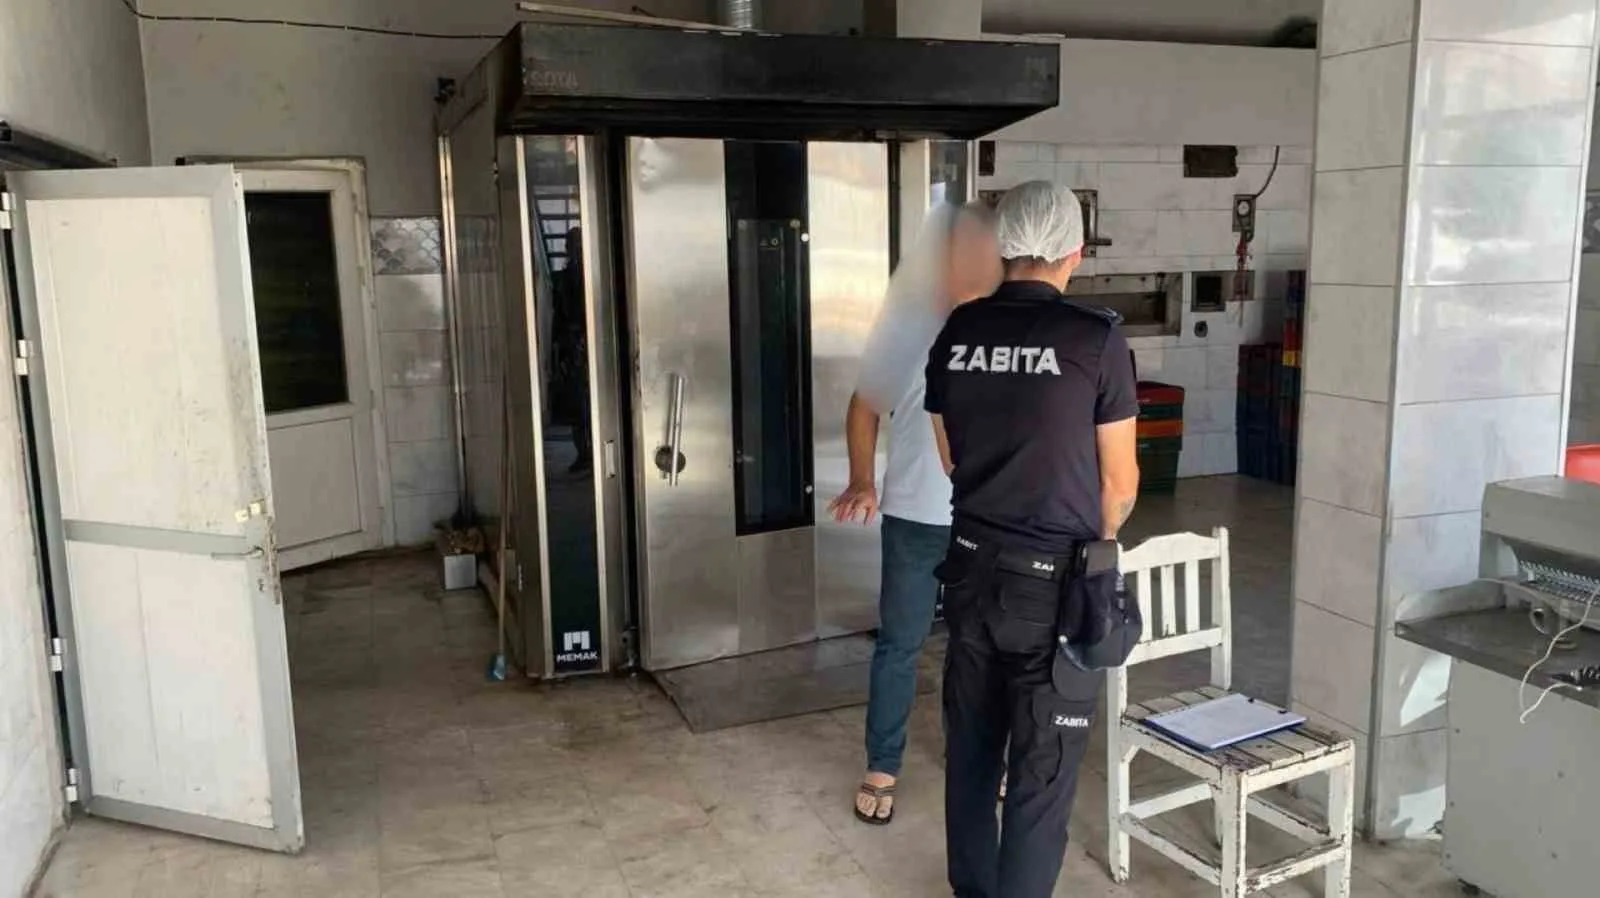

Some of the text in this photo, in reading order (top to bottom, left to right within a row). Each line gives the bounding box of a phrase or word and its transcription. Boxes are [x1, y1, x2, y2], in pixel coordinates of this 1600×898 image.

[947, 344, 1062, 375] ZABITA
[556, 651, 598, 662] MEMAK
[1055, 715, 1089, 727] ZABITA
